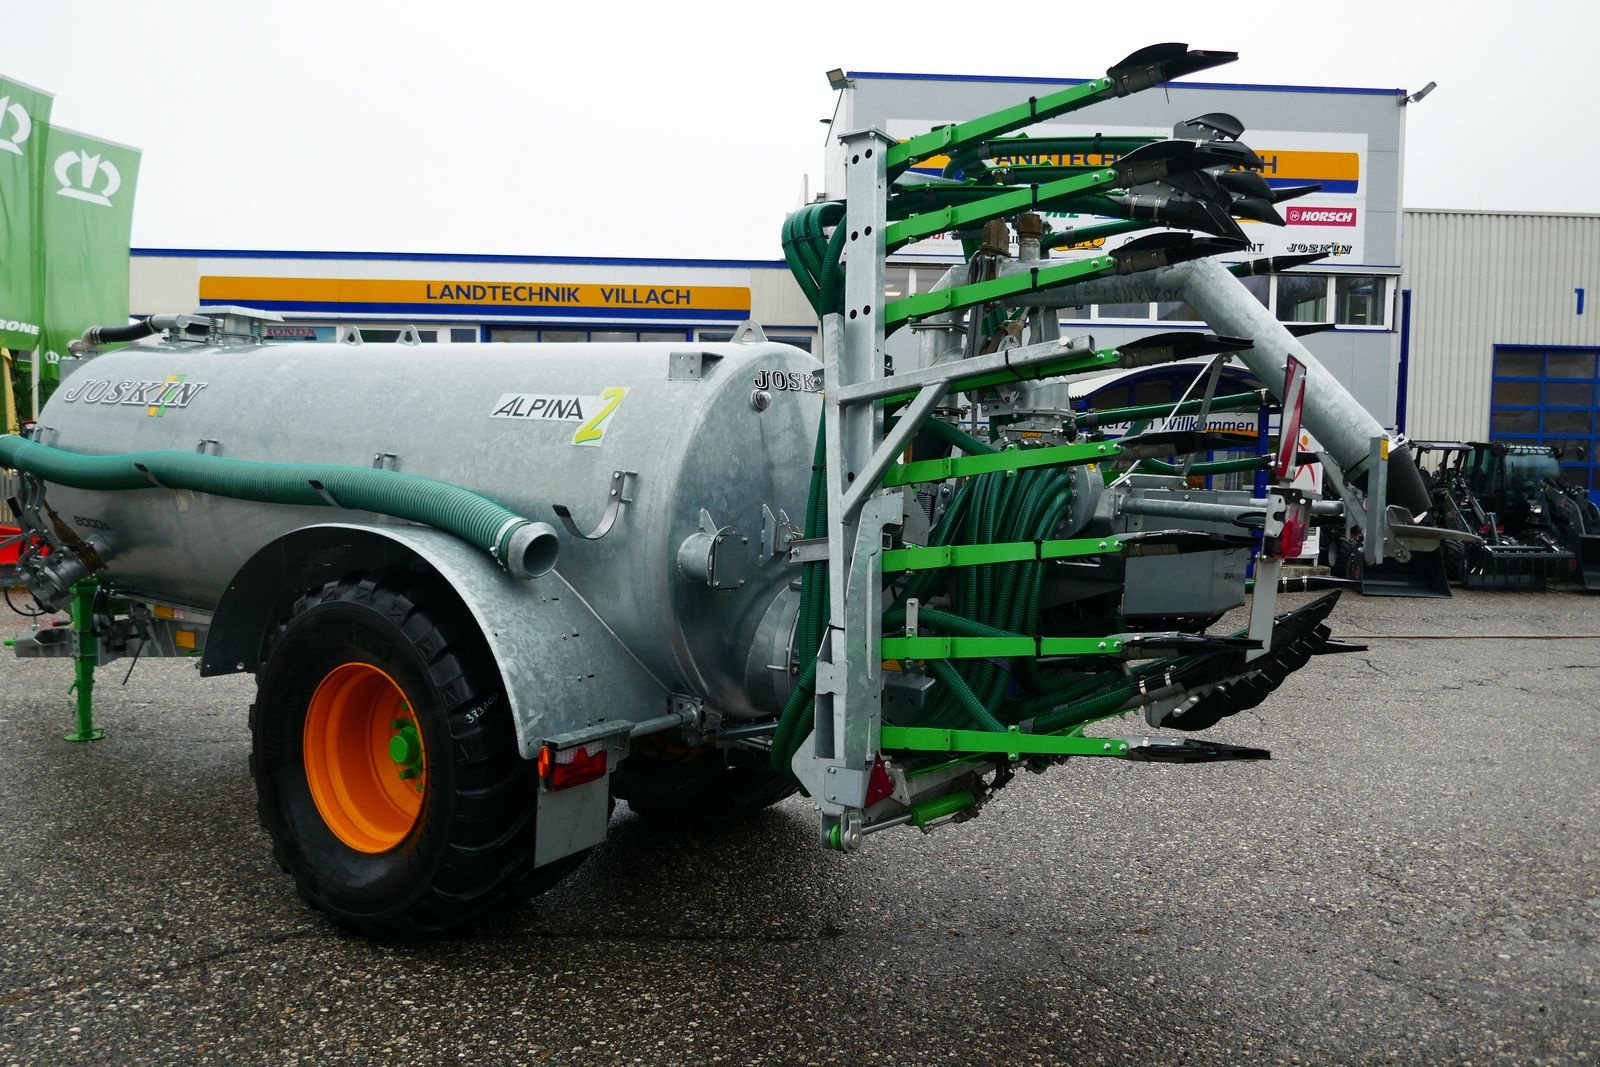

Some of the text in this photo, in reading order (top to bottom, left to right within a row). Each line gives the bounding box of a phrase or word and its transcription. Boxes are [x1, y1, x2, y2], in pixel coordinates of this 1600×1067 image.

[1301, 211, 1353, 223] HORSCH
[1286, 242, 1353, 255] JOSKIN
[426, 283, 691, 305] LANDTECHNIK VILLACH
[1574, 288, 1585, 315] 1
[753, 369, 815, 392] JOSK
[64, 379, 208, 408] JOSKIN
[493, 386, 625, 444] ALPINA 2
